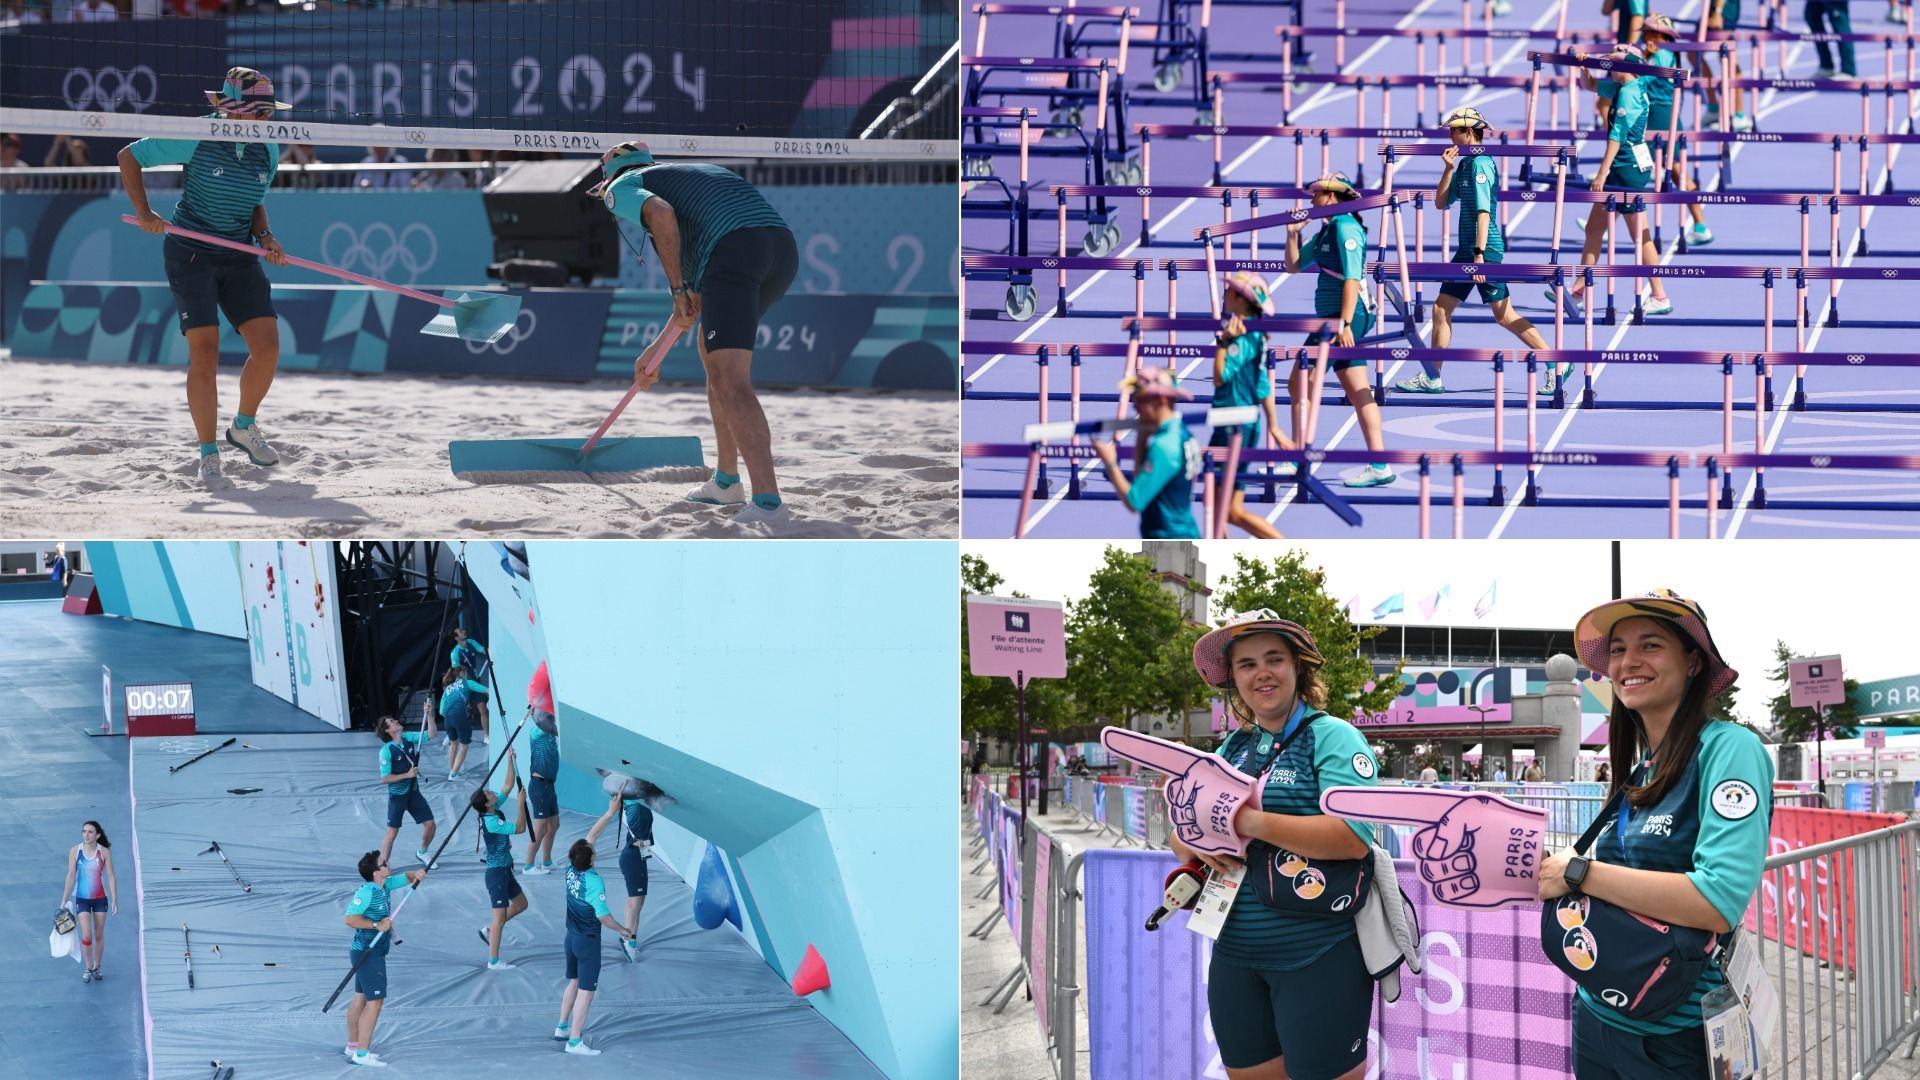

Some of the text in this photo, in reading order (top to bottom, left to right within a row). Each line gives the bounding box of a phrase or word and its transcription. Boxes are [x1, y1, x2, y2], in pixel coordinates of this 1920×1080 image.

[511, 51, 706, 116] 2024
[266, 125, 312, 140] 2024
[562, 135, 601, 150] 2024
[816, 142, 850, 155] 2024
[1174, 347, 1201, 356] 2024
[1632, 353, 1659, 361] 2024
[251, 605, 266, 665] A
[991, 634, 1046, 645] File d'attente
[295, 622, 312, 687] B
[994, 644, 1043, 654] Waiting Line
[127, 689, 192, 710] 00:07
[1350, 710, 1415, 725] trance 2
[1270, 776, 1296, 785] 2024
[1220, 796, 1240, 837] 2024
[1640, 823, 1672, 837] 2024
[1519, 829, 1539, 879] 2024
